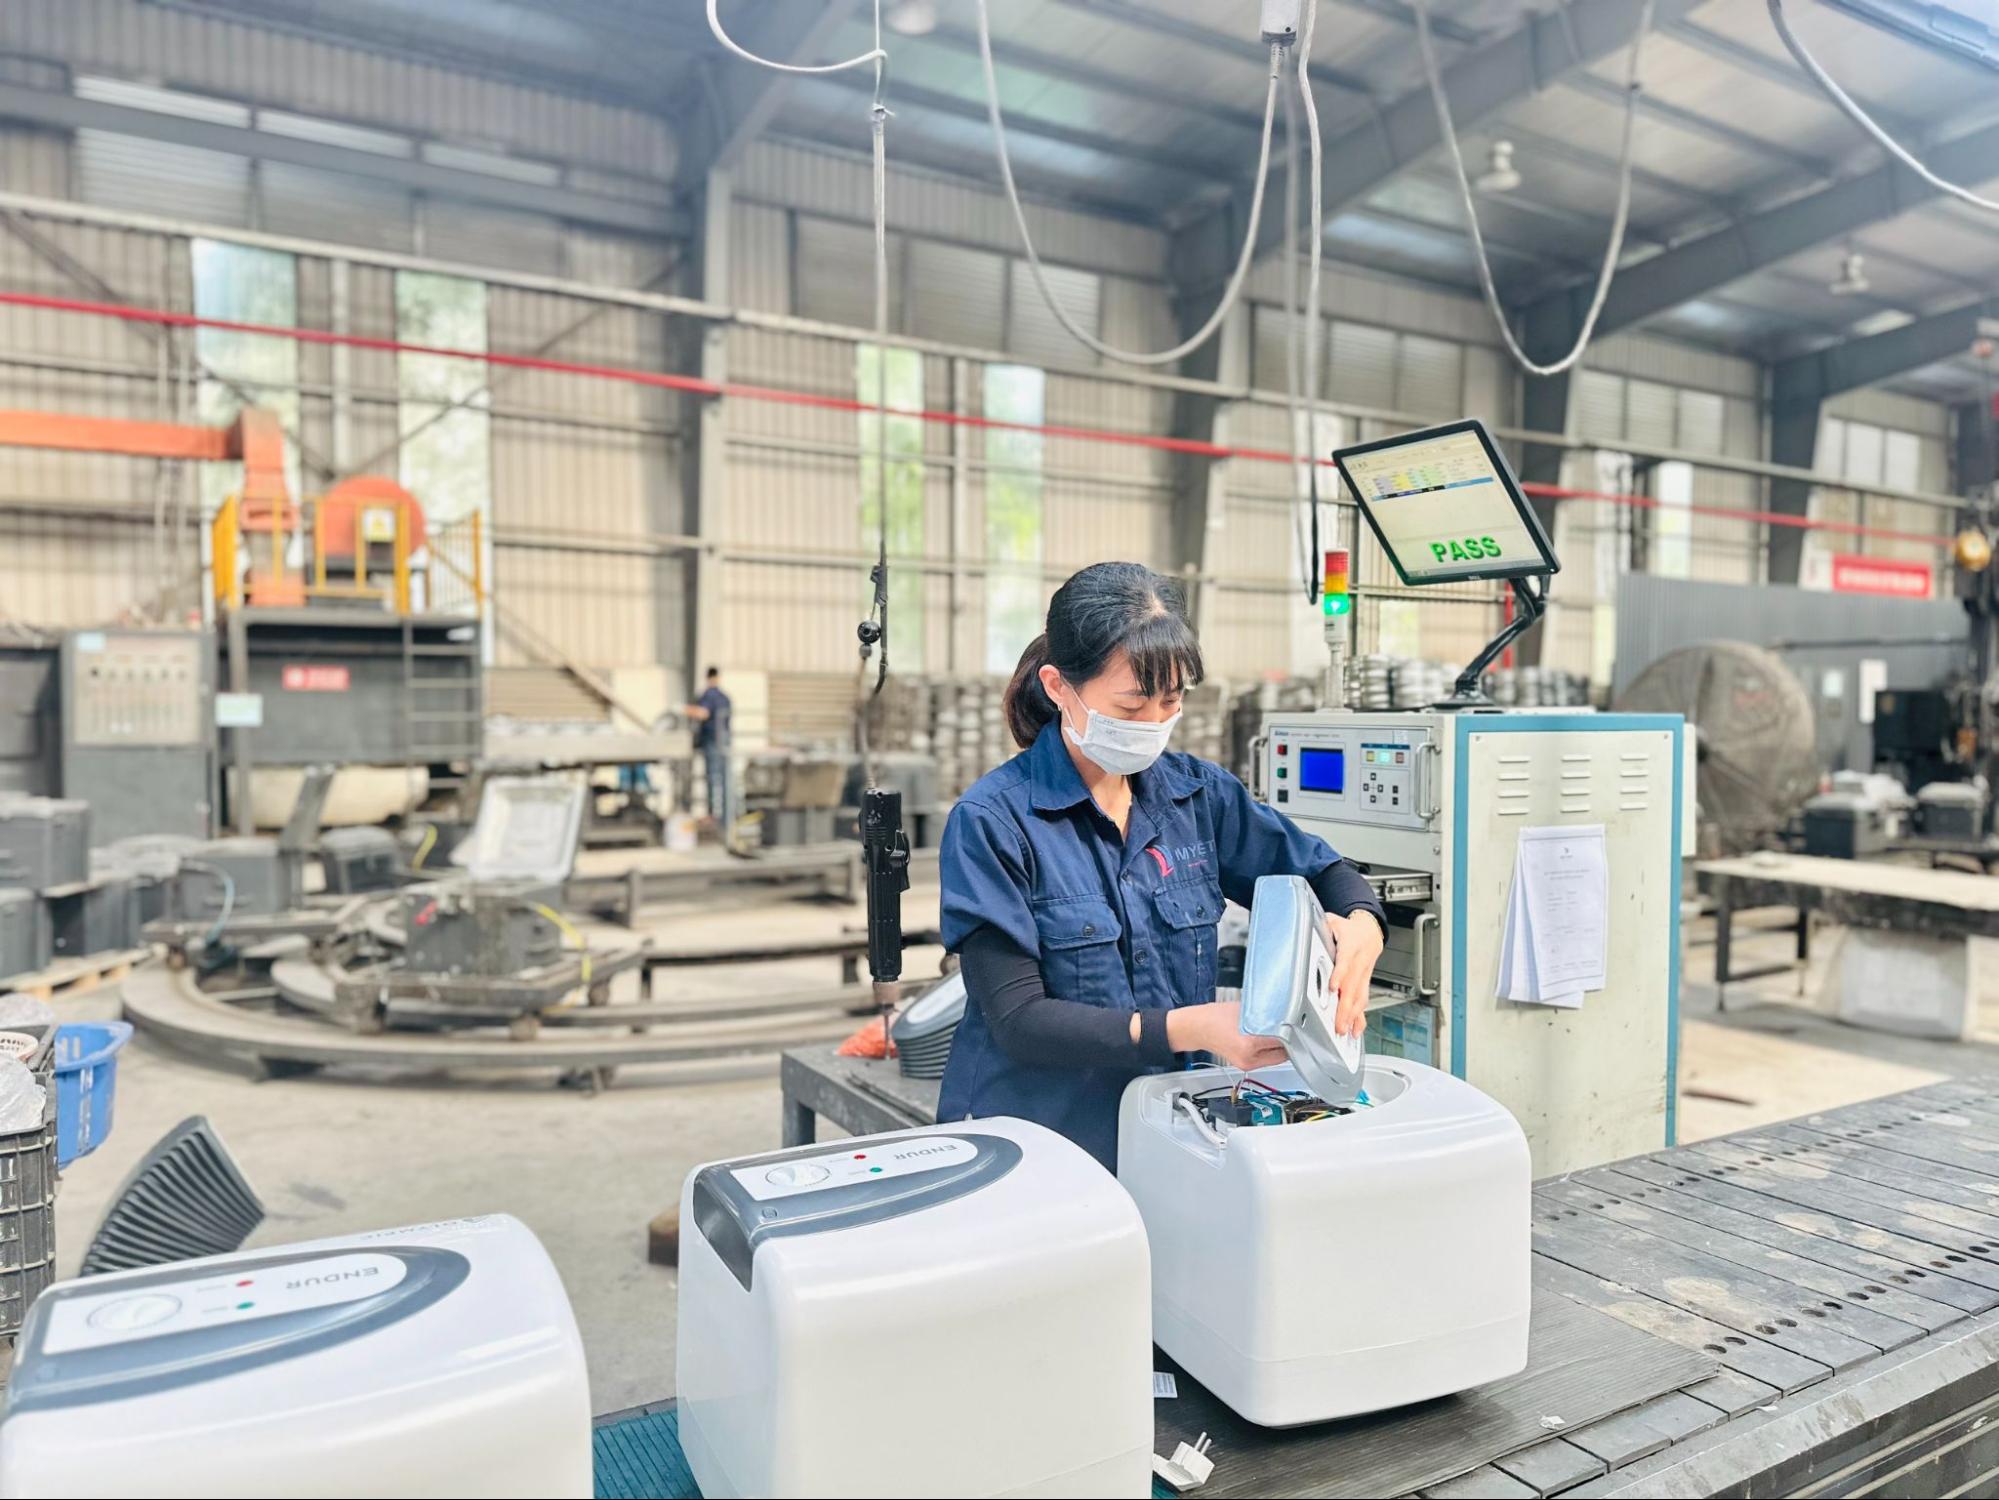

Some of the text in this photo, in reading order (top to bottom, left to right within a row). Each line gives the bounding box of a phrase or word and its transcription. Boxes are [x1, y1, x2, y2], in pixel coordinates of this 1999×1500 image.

[1429, 535, 1502, 563] PASS
[893, 1144, 957, 1160] ENDUR
[286, 1266, 379, 1289] ENDUR
